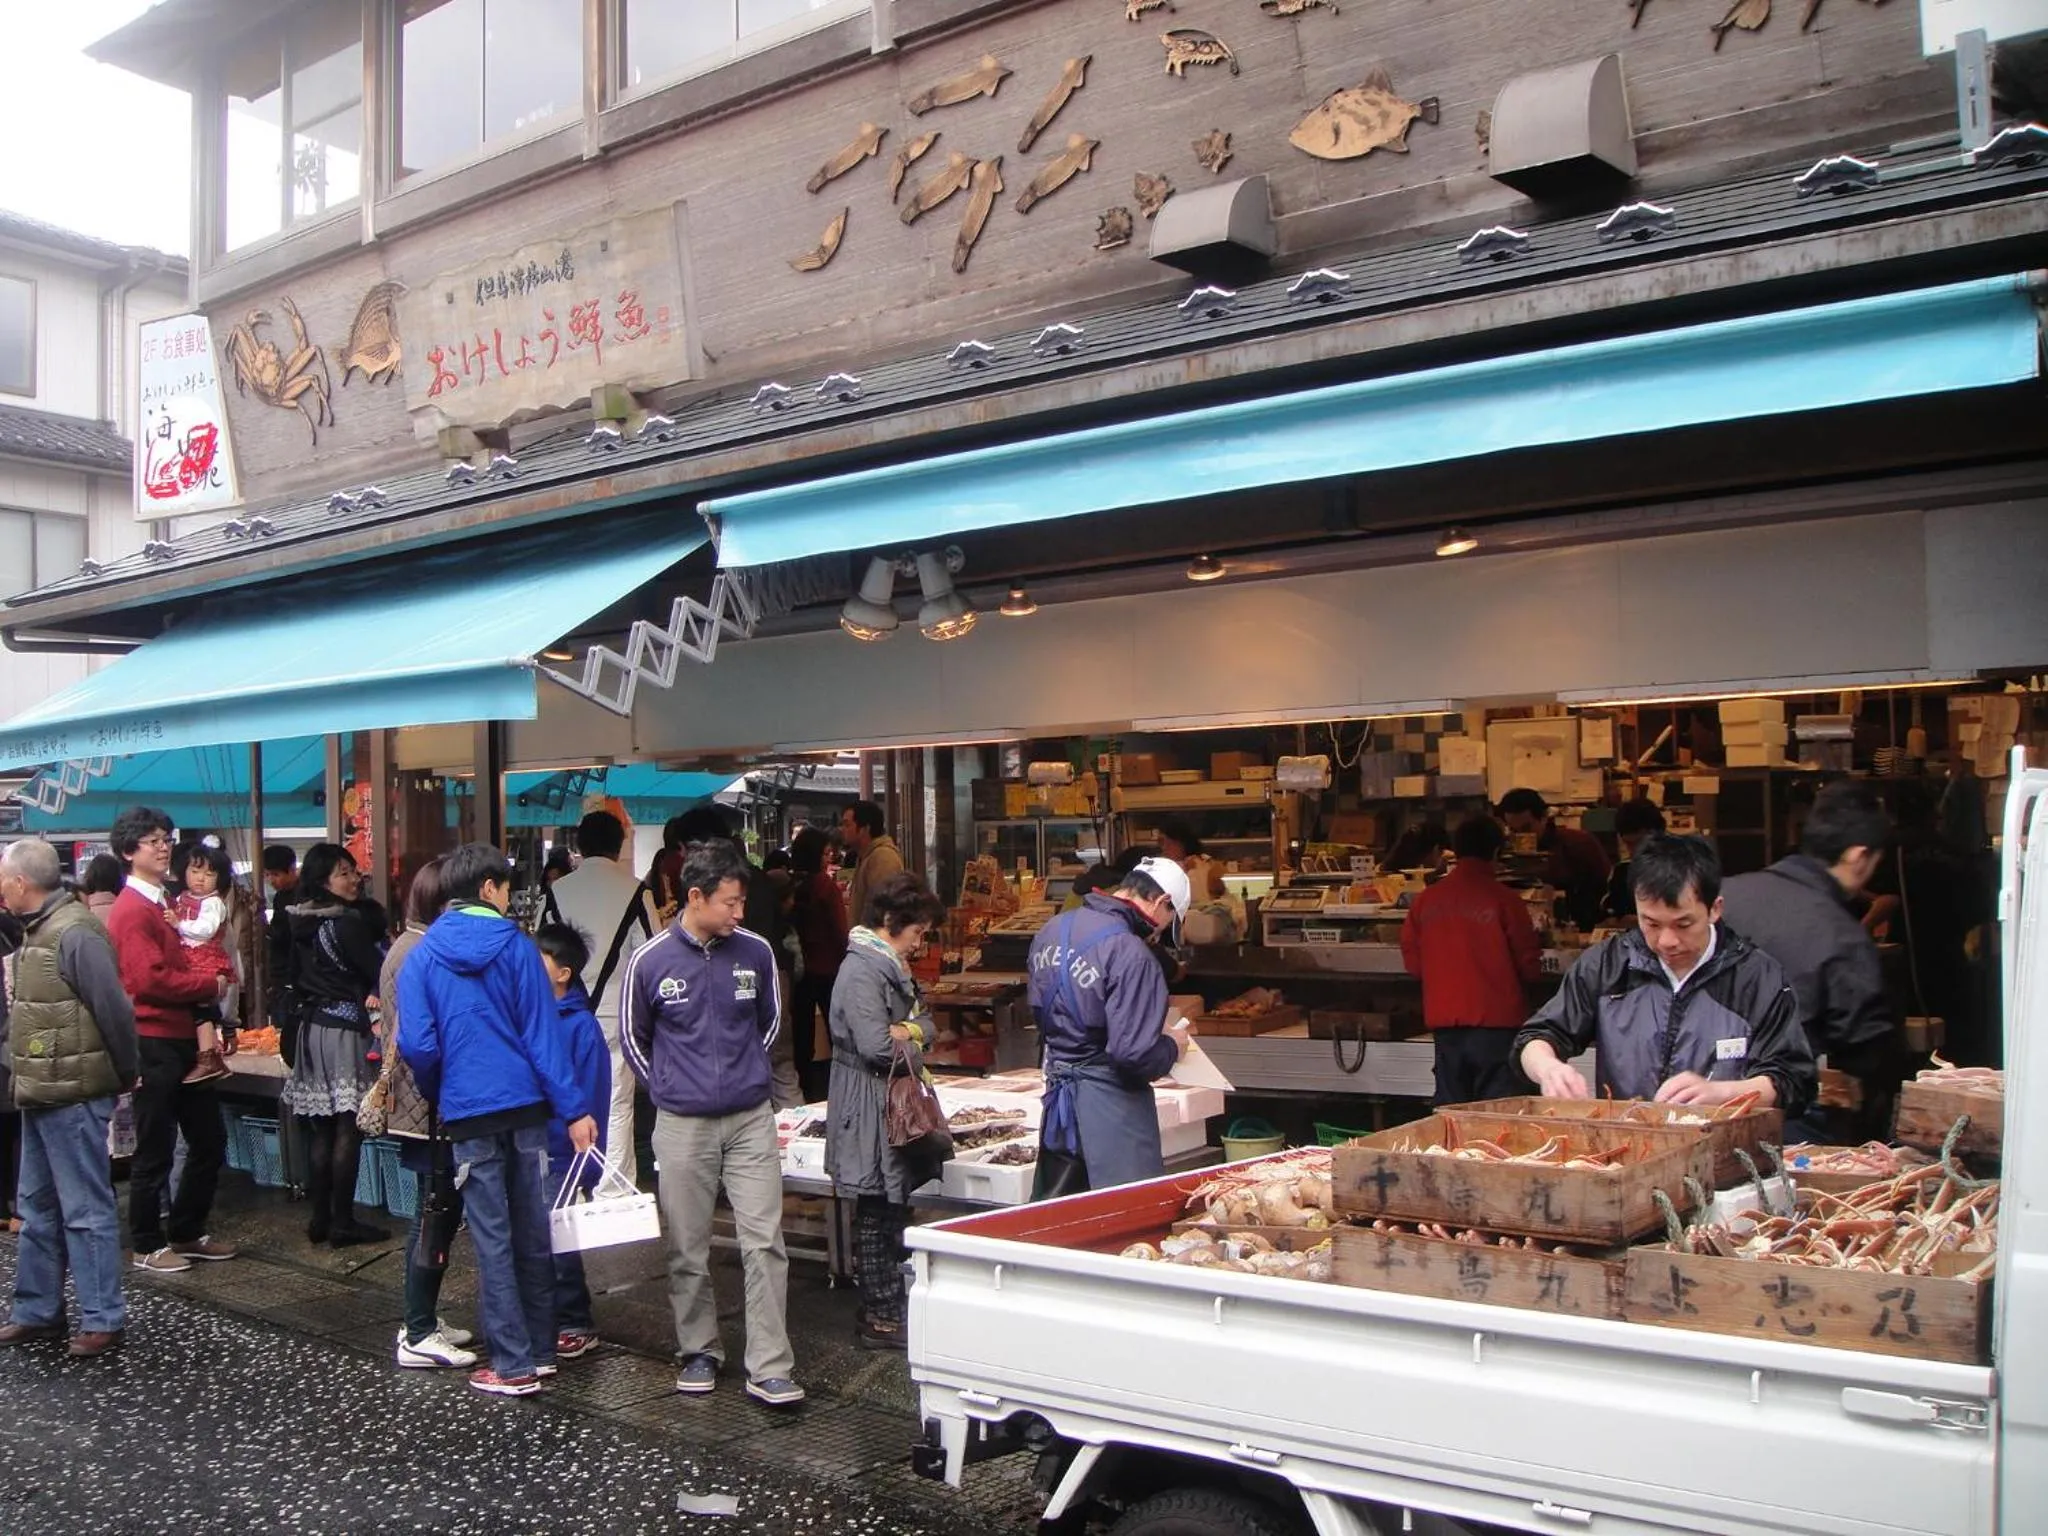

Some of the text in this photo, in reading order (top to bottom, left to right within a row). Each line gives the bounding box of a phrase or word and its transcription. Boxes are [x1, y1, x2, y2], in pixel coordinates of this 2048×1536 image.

[161, 327, 207, 361] お食事処
[427, 289, 652, 398] おけしょう鮮魚
